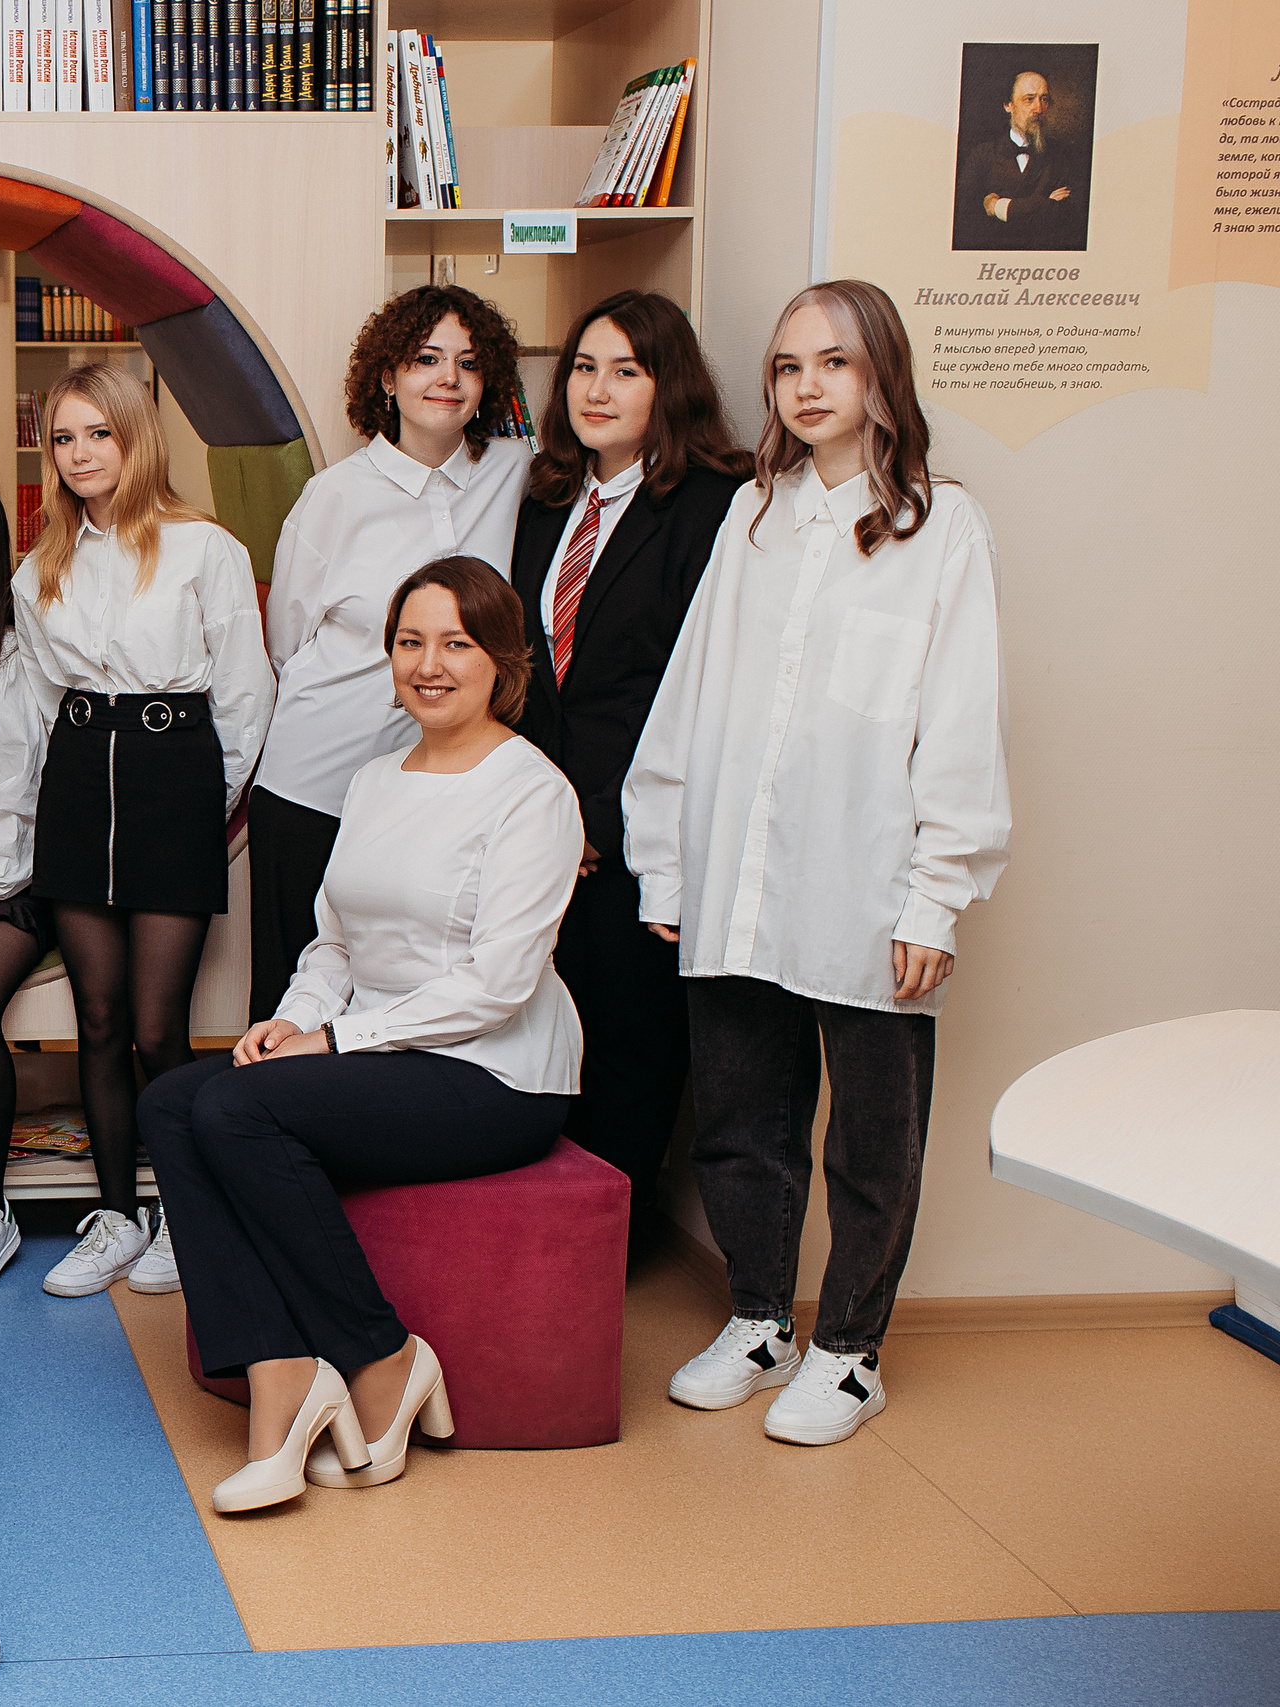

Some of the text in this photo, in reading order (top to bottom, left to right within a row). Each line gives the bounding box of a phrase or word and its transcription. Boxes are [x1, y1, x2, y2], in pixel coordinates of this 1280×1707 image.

[262, 44, 277, 70] Узала
[280, 45, 294, 70] Узала
[299, 43, 314, 68] Узала
[261, 73, 278, 102] Дерсу
[279, 73, 295, 102] Дерсу
[297, 72, 314, 101] Дерсу
[408, 61, 424, 127] Древний мир
[1219, 114, 1277, 126] любовь к
[1218, 132, 1237, 146] да,
[1239, 135, 1260, 144] та
[1217, 153, 1258, 164] земле,
[1216, 168, 1272, 182] которой
[1215, 186, 1248, 198] было
[1213, 206, 1242, 217] мне,
[510, 222, 566, 245] Энциклопедии
[1211, 222, 1223, 233] Я
[1223, 224, 1256, 233] знаю
[976, 262, 1081, 286] Некрасов
[913, 287, 1141, 307] Николай Алексеевич
[934, 325, 1142, 339] В минуты унынья, о Родина-мать!
[932, 342, 1088, 357] Я мыслью вперед улетаю,
[932, 360, 1150, 374] Еще суждено тебе много страдать,
[931, 377, 1103, 391] Но ты не погибнешь, я знаю.
